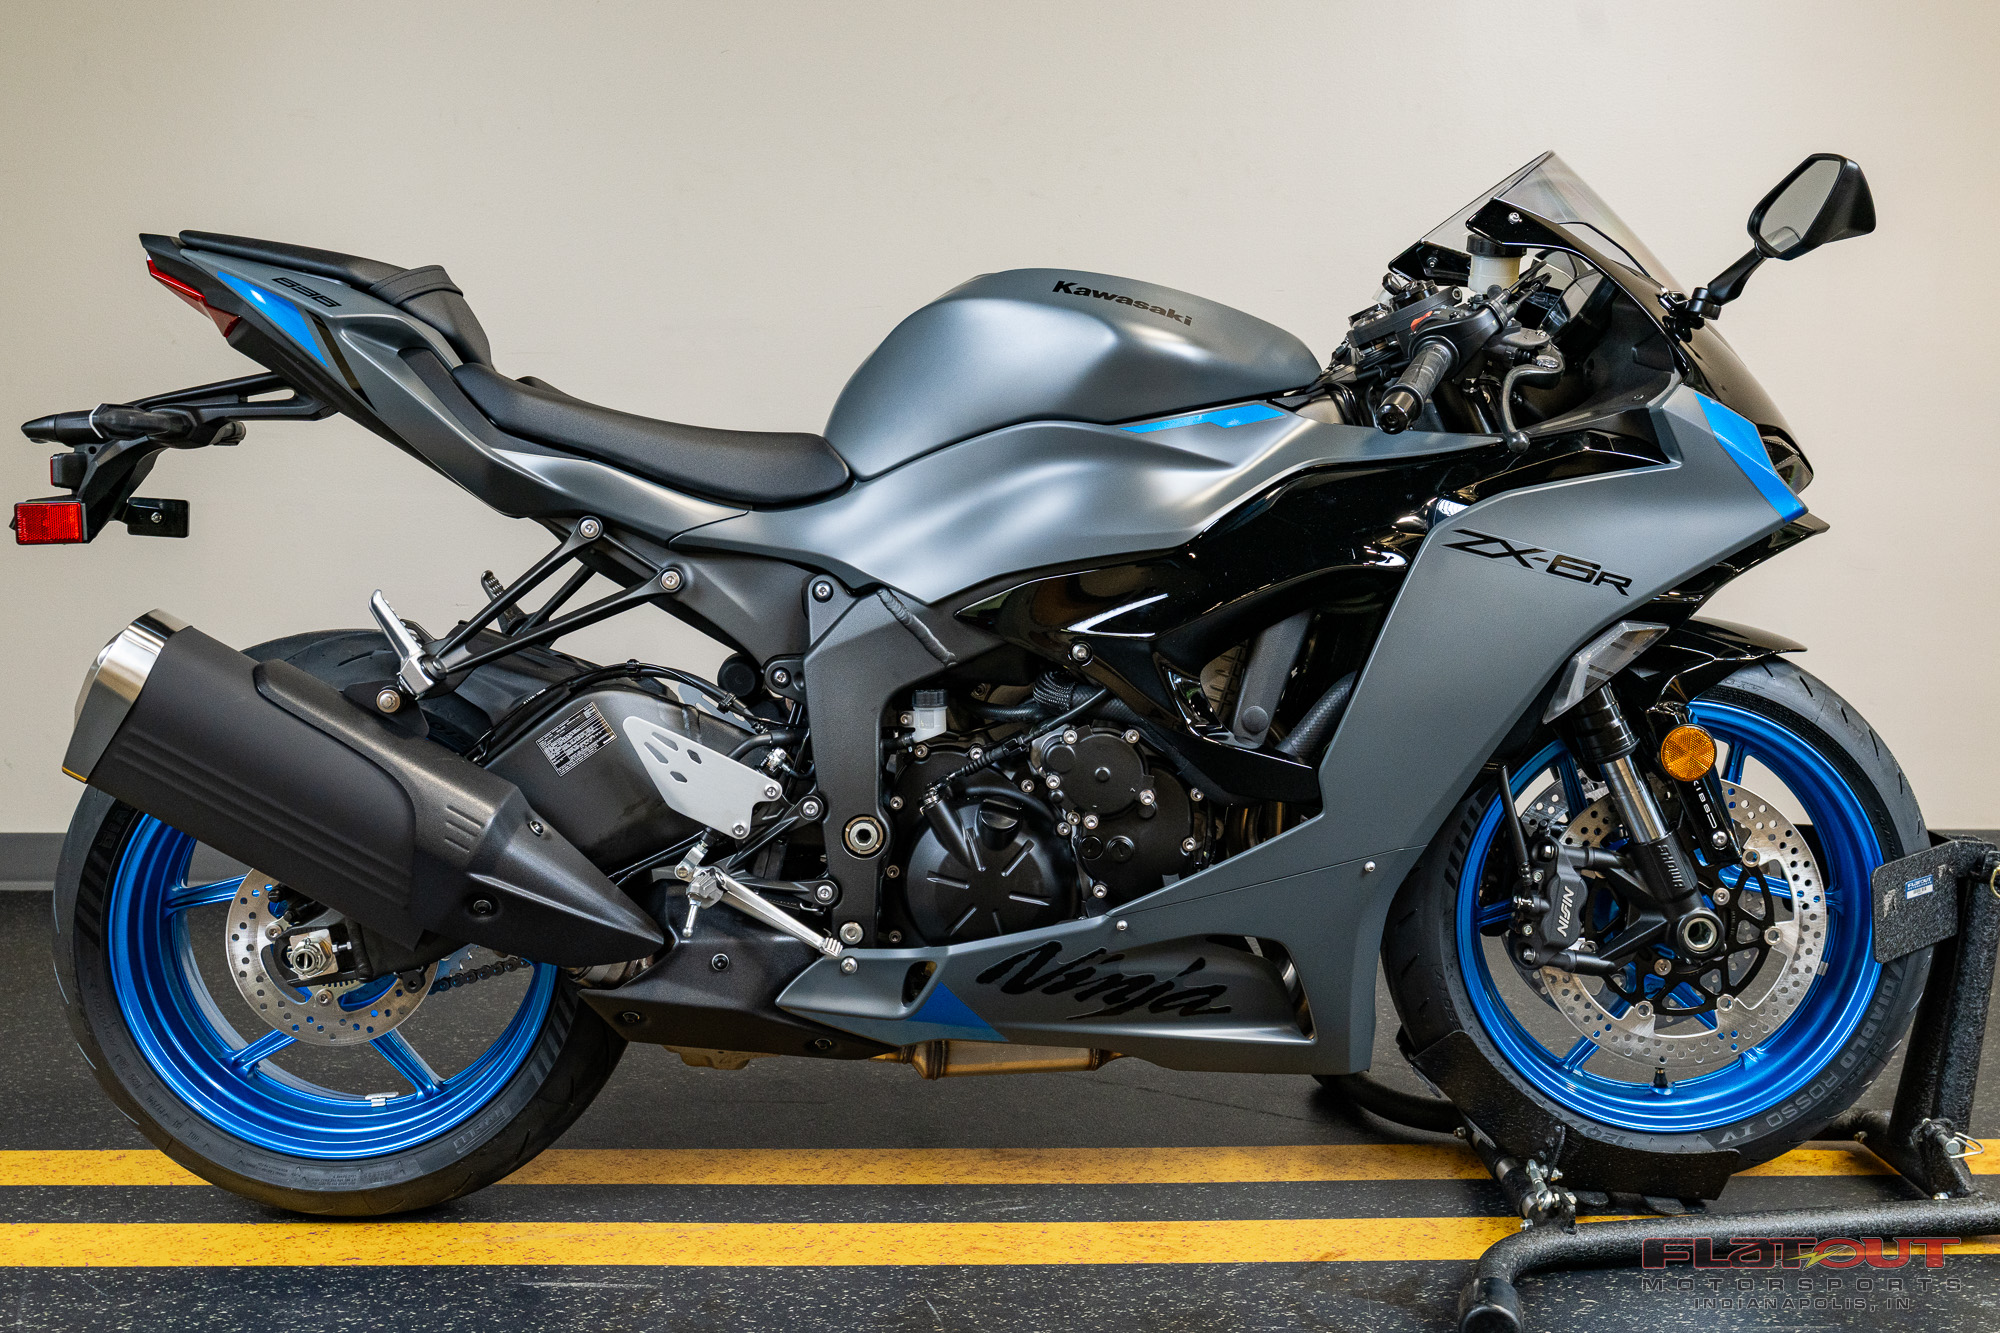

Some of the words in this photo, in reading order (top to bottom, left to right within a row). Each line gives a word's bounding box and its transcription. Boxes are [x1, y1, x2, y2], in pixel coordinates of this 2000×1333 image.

[272, 277, 342, 307] 636
[1051, 280, 1193, 327] Kawasaki
[1442, 529, 1632, 597] ZX-6R
[1657, 844, 1685, 888] SHOWA
[976, 940, 1232, 1020] Ninja
[1840, 979, 1898, 1068] DIABLO
[1766, 1071, 1839, 1127] ROSSO
[451, 1103, 513, 1155] PIRELLI
[1717, 1122, 1757, 1144] IV
